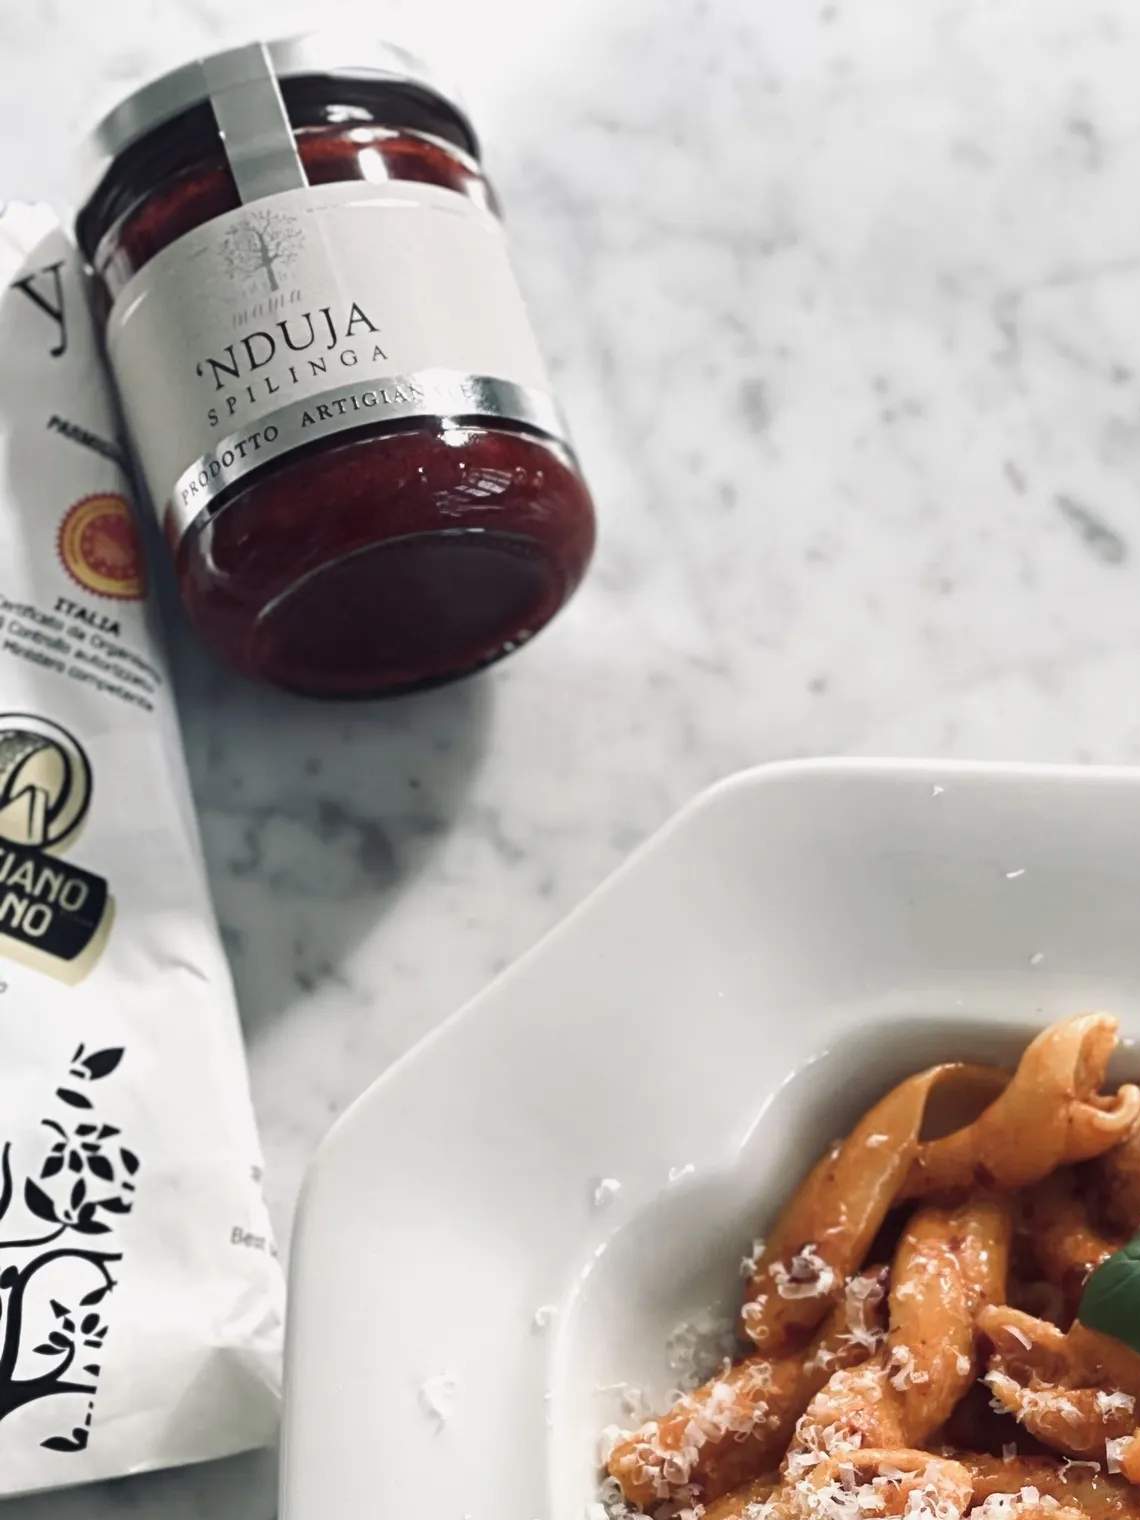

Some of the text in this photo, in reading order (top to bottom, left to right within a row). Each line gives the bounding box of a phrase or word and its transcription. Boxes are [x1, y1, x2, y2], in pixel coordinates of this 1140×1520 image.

[196, 302, 380, 391] 'NDUJA
[207, 345, 389, 427] SPILINGA
[181, 425, 279, 506] PRODOTTO
[0, 594, 64, 631] ertificato
[54, 597, 121, 637] ITALIA
[0, 849, 88, 912] IANO
